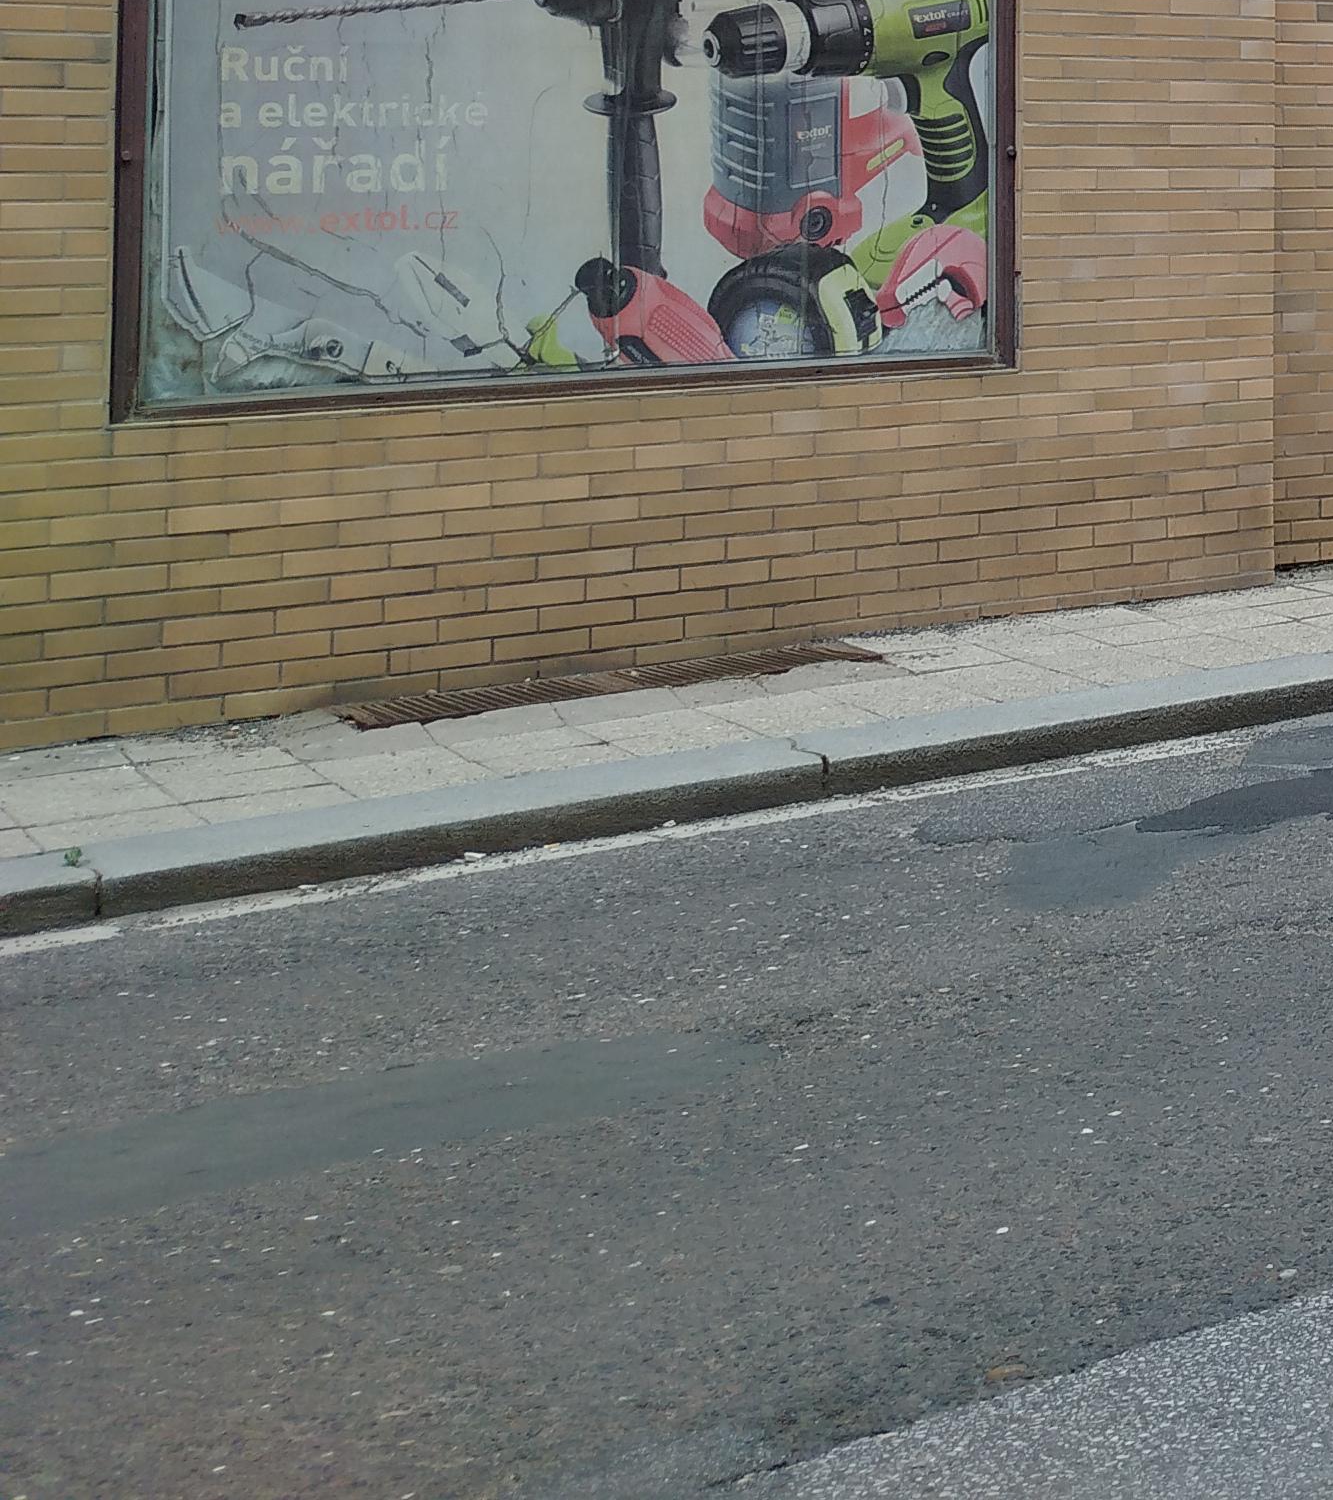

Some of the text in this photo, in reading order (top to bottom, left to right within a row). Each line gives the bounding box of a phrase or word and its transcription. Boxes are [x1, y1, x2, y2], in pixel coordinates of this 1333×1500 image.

[219, 44, 350, 82] Ruční
[219, 92, 490, 128] a elektrické
[219, 136, 452, 195] nářadí
